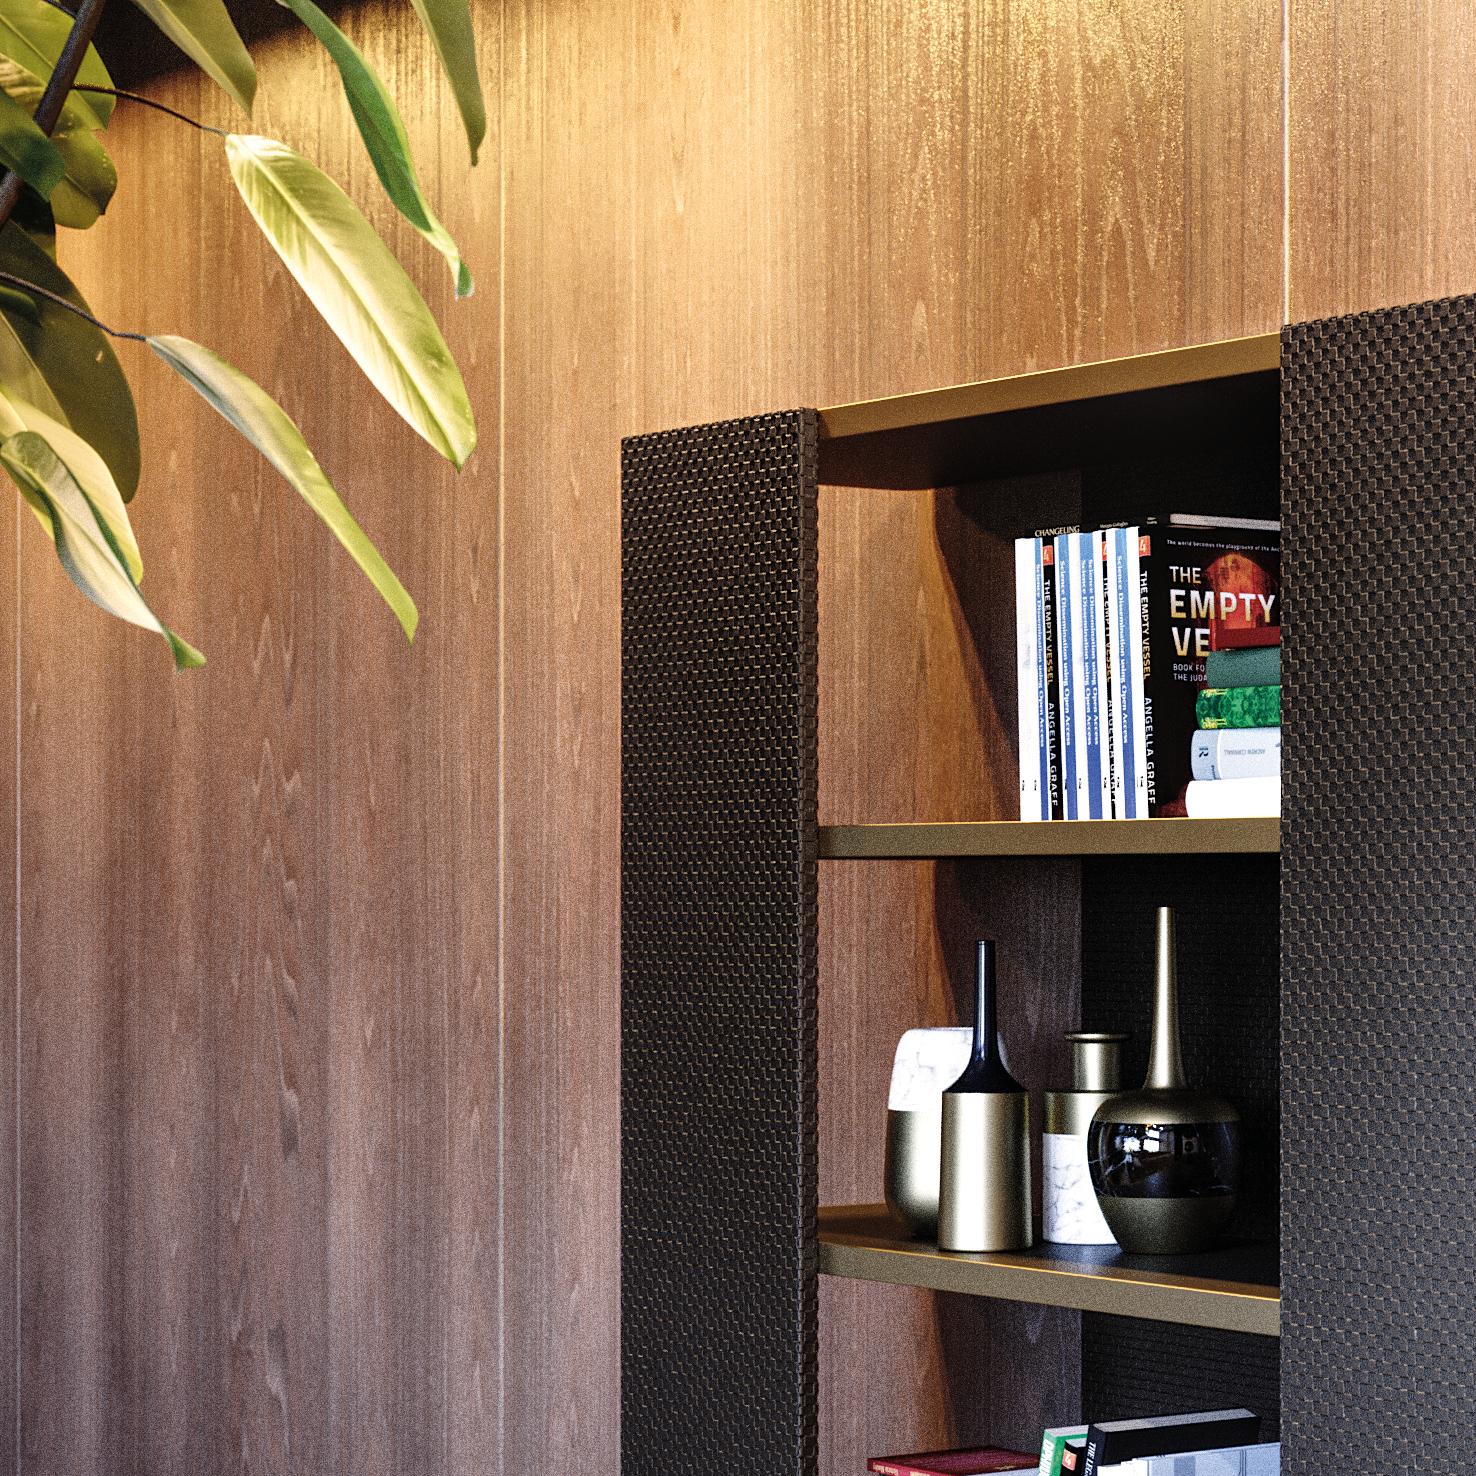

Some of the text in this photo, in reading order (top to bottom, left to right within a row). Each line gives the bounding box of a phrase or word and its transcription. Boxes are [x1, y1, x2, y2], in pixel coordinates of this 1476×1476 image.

[1034, 524, 1081, 537] CHANGELING
[1140, 538, 1147, 553] 4
[1169, 565, 1202, 584] THE
[1169, 588, 1276, 623] EMPTY
[1044, 604, 1052, 642] EMPTY
[1139, 570, 1151, 680] THE EMPTY VESSEL
[1046, 643, 1054, 686] VESSEL
[1173, 663, 1194, 671] BOOK
[1173, 673, 1188, 681] THE
[1047, 702, 1059, 807] ANGELLA GRAFF
[1144, 697, 1157, 805] ANGELLA GRAFF
[1087, 1441, 1097, 1459] THE
